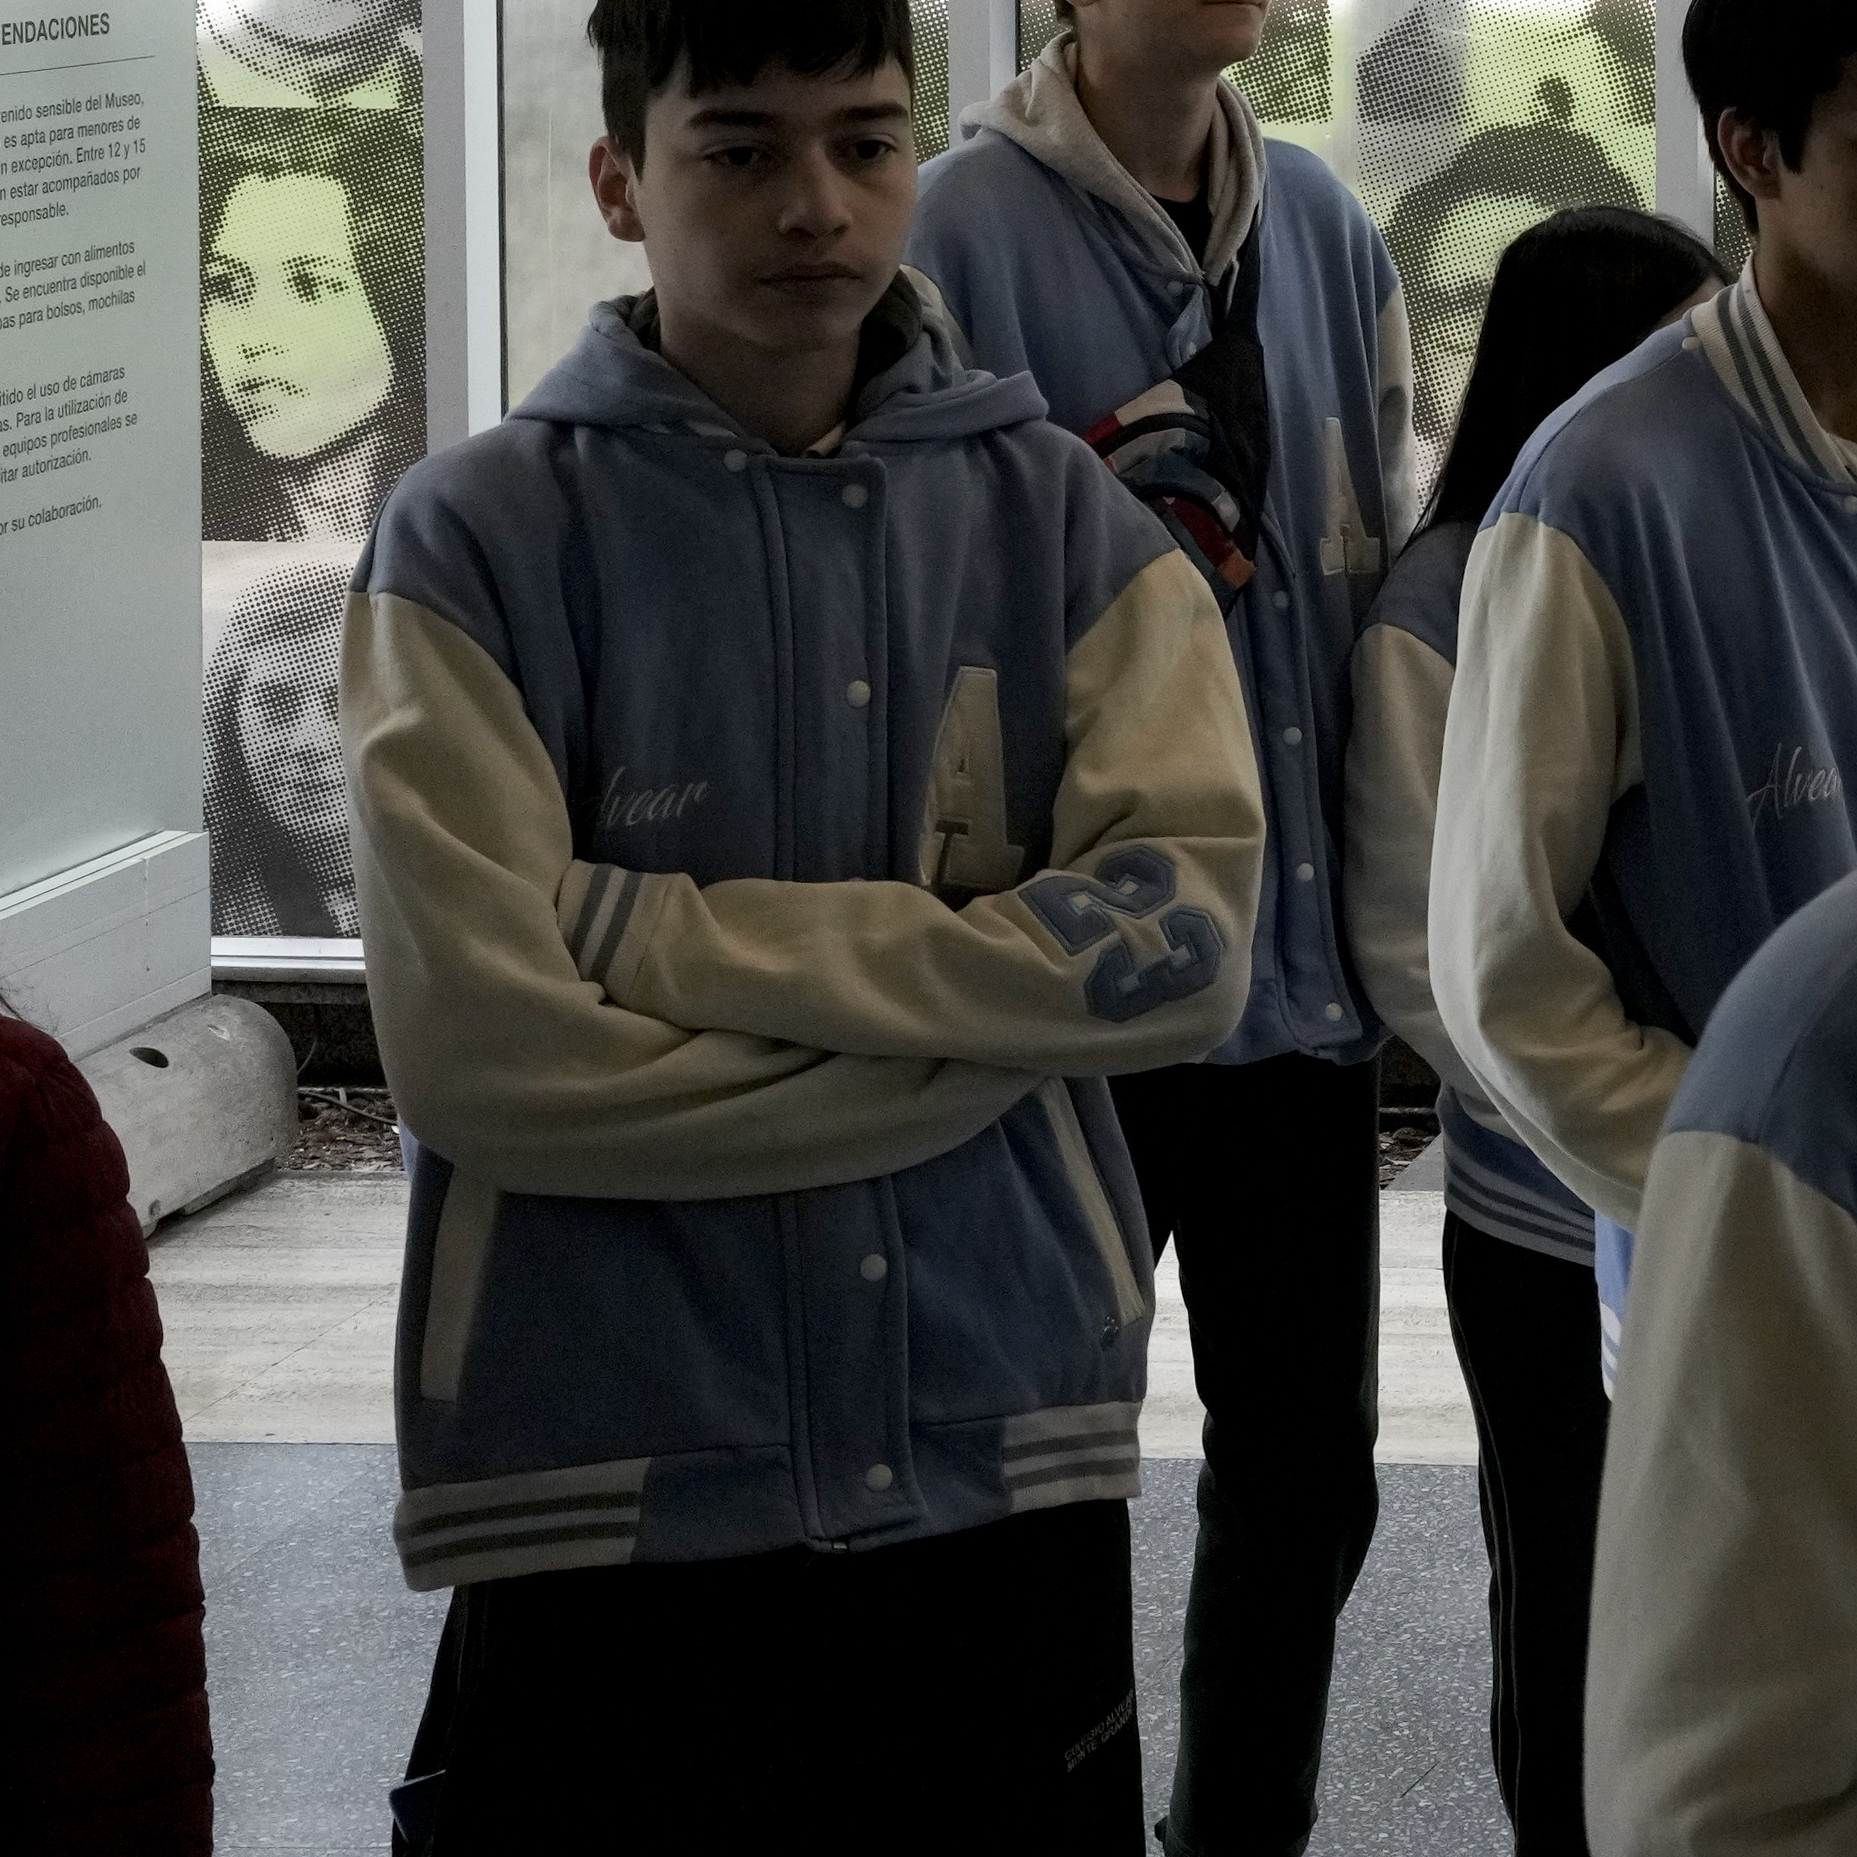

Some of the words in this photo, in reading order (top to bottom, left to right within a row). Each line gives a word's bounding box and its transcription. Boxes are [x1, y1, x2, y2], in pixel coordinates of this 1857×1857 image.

[1, 12, 111, 46] ENDACIONES
[0, 104, 33, 124] enido
[36, 98, 82, 119] sensible
[85, 94, 102, 112] del
[105, 92, 144, 109] Museo,
[4, 135, 17, 149] es
[20, 128, 46, 148] apta
[49, 126, 74, 146] para
[77, 119, 124, 138] menores
[127, 115, 141, 131] de
[11, 150, 73, 174] excepción.
[76, 146, 105, 164] Entre
[108, 141, 121, 158] 12
[124, 143, 130, 160] y
[133, 138, 146, 154] 15
[10, 181, 39, 200] estar
[42, 169, 120, 193] acompañados
[123, 166, 141, 185] por
[14, 255, 59, 278] ingresar
[61, 251, 81, 267] con
[84, 241, 135, 262] alimentos
[5, 286, 20, 303] Se
[23, 276, 77, 299] encuentra
[80, 264, 134, 289] disponible
[137, 261, 146, 277] el
[19, 309, 44, 330] para
[47, 302, 85, 320] bolsos,
[88, 290, 136, 312] mochilas
[27, 383, 36, 401] el
[40, 382, 60, 398] uso
[63, 375, 77, 392] de
[80, 366, 126, 389] cámaras
[16, 411, 42, 429] Para
[45, 406, 54, 421] la
[58, 392, 111, 419] utilización
[114, 389, 128, 405] de
[2, 435, 48, 459] equipos
[51, 415, 122, 449] profesionales
[125, 412, 138, 427] se
[22, 447, 92, 479] autorización.
[12, 516, 25, 532] su
[28, 494, 102, 528] colaboración.
[1745, 742, 1843, 832] Alvea
